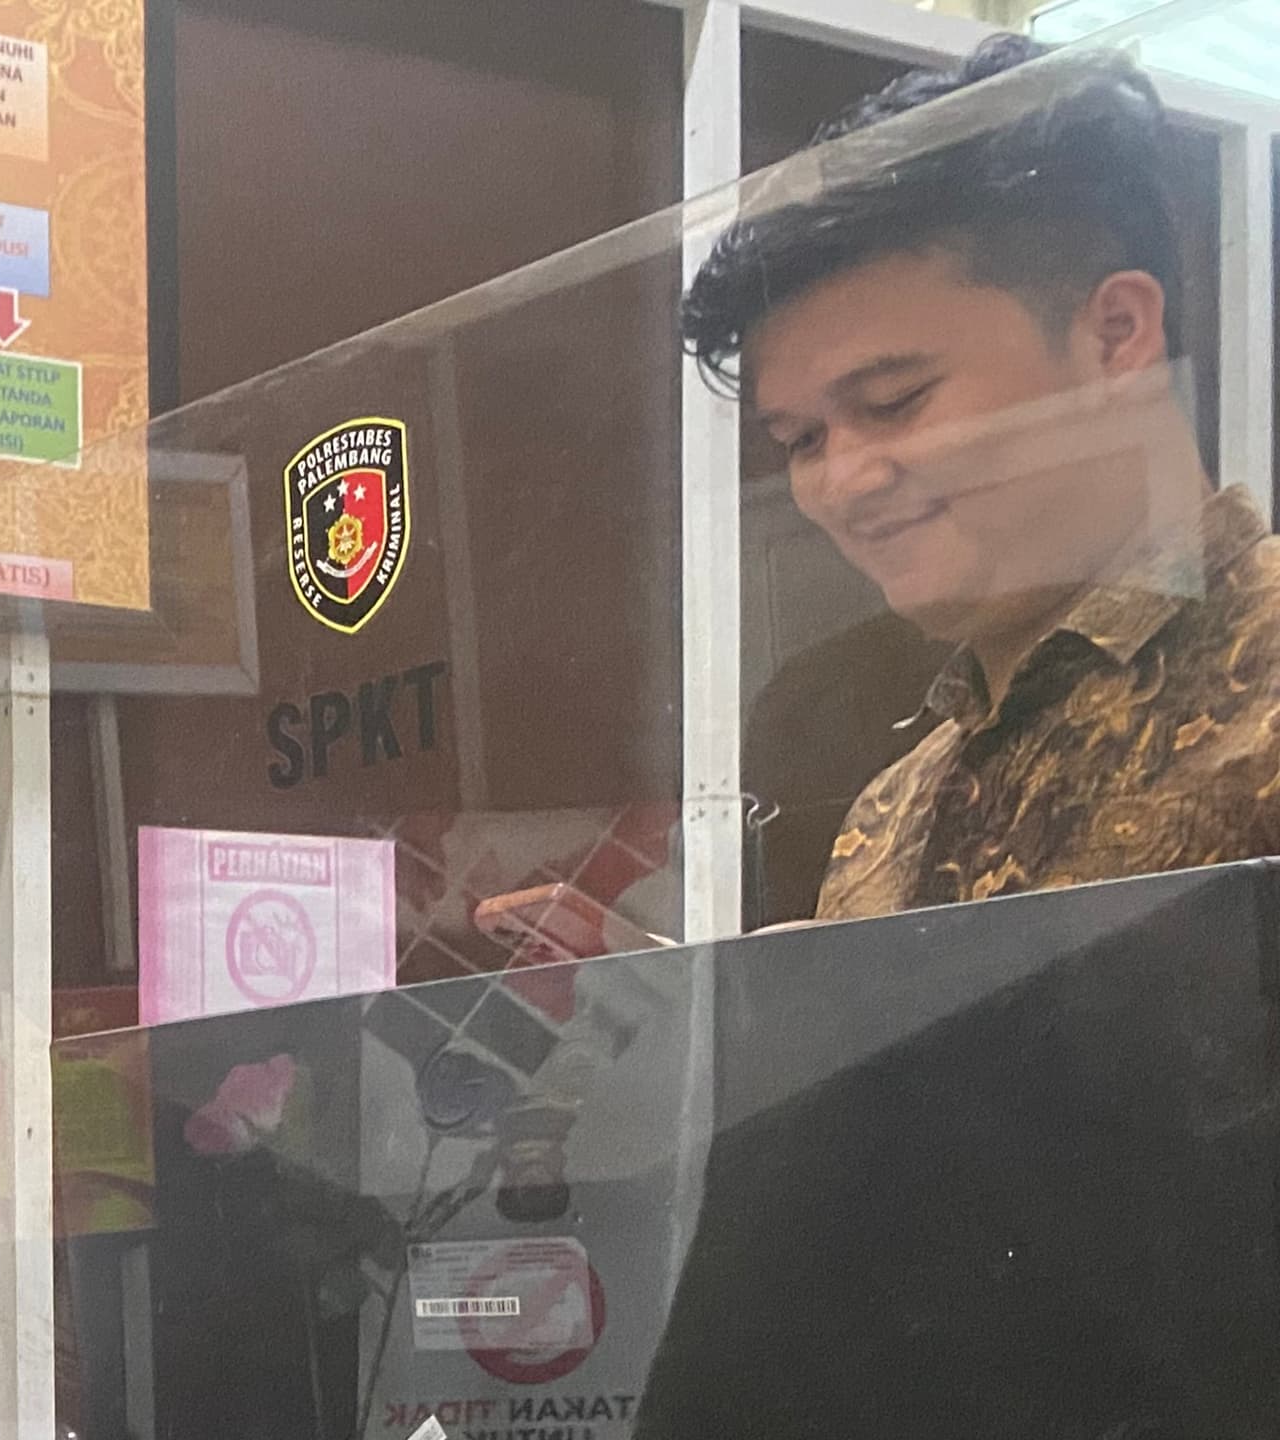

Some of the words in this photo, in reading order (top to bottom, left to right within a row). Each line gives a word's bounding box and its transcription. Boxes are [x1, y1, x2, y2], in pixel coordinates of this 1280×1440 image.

[0, 384, 53, 407] TANDA
[296, 428, 393, 478] POLRESTABES
[296, 447, 393, 497] PALEMBANG
[292, 515, 323, 609] RESERSE
[376, 483, 403, 586] KRIMINAL
[266, 659, 451, 791] SPKT
